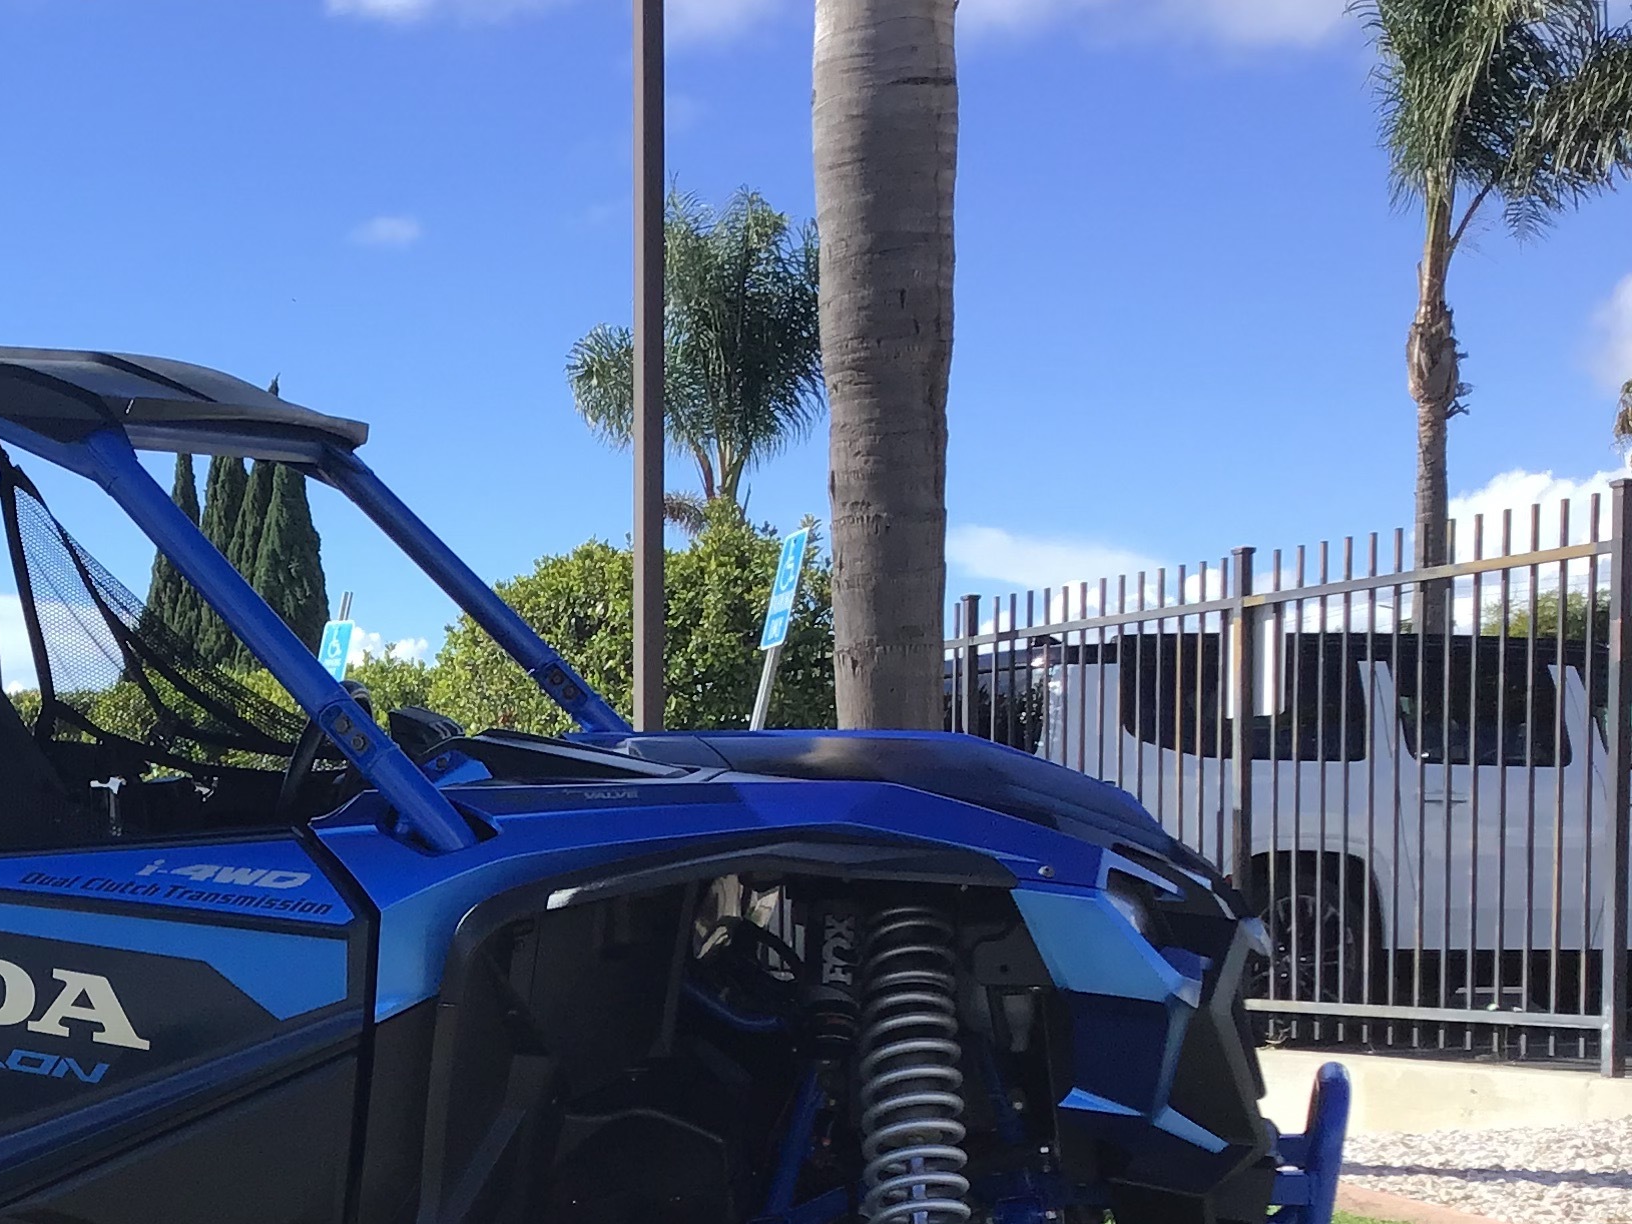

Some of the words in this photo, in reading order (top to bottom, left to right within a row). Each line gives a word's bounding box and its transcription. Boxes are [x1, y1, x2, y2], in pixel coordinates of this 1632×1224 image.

[18, 871, 74, 889] Dual
[81, 876, 160, 898] Clutch
[163, 885, 334, 915] Transmission
[135, 858, 312, 889] i-4WD
[822, 913, 862, 986] FOX
